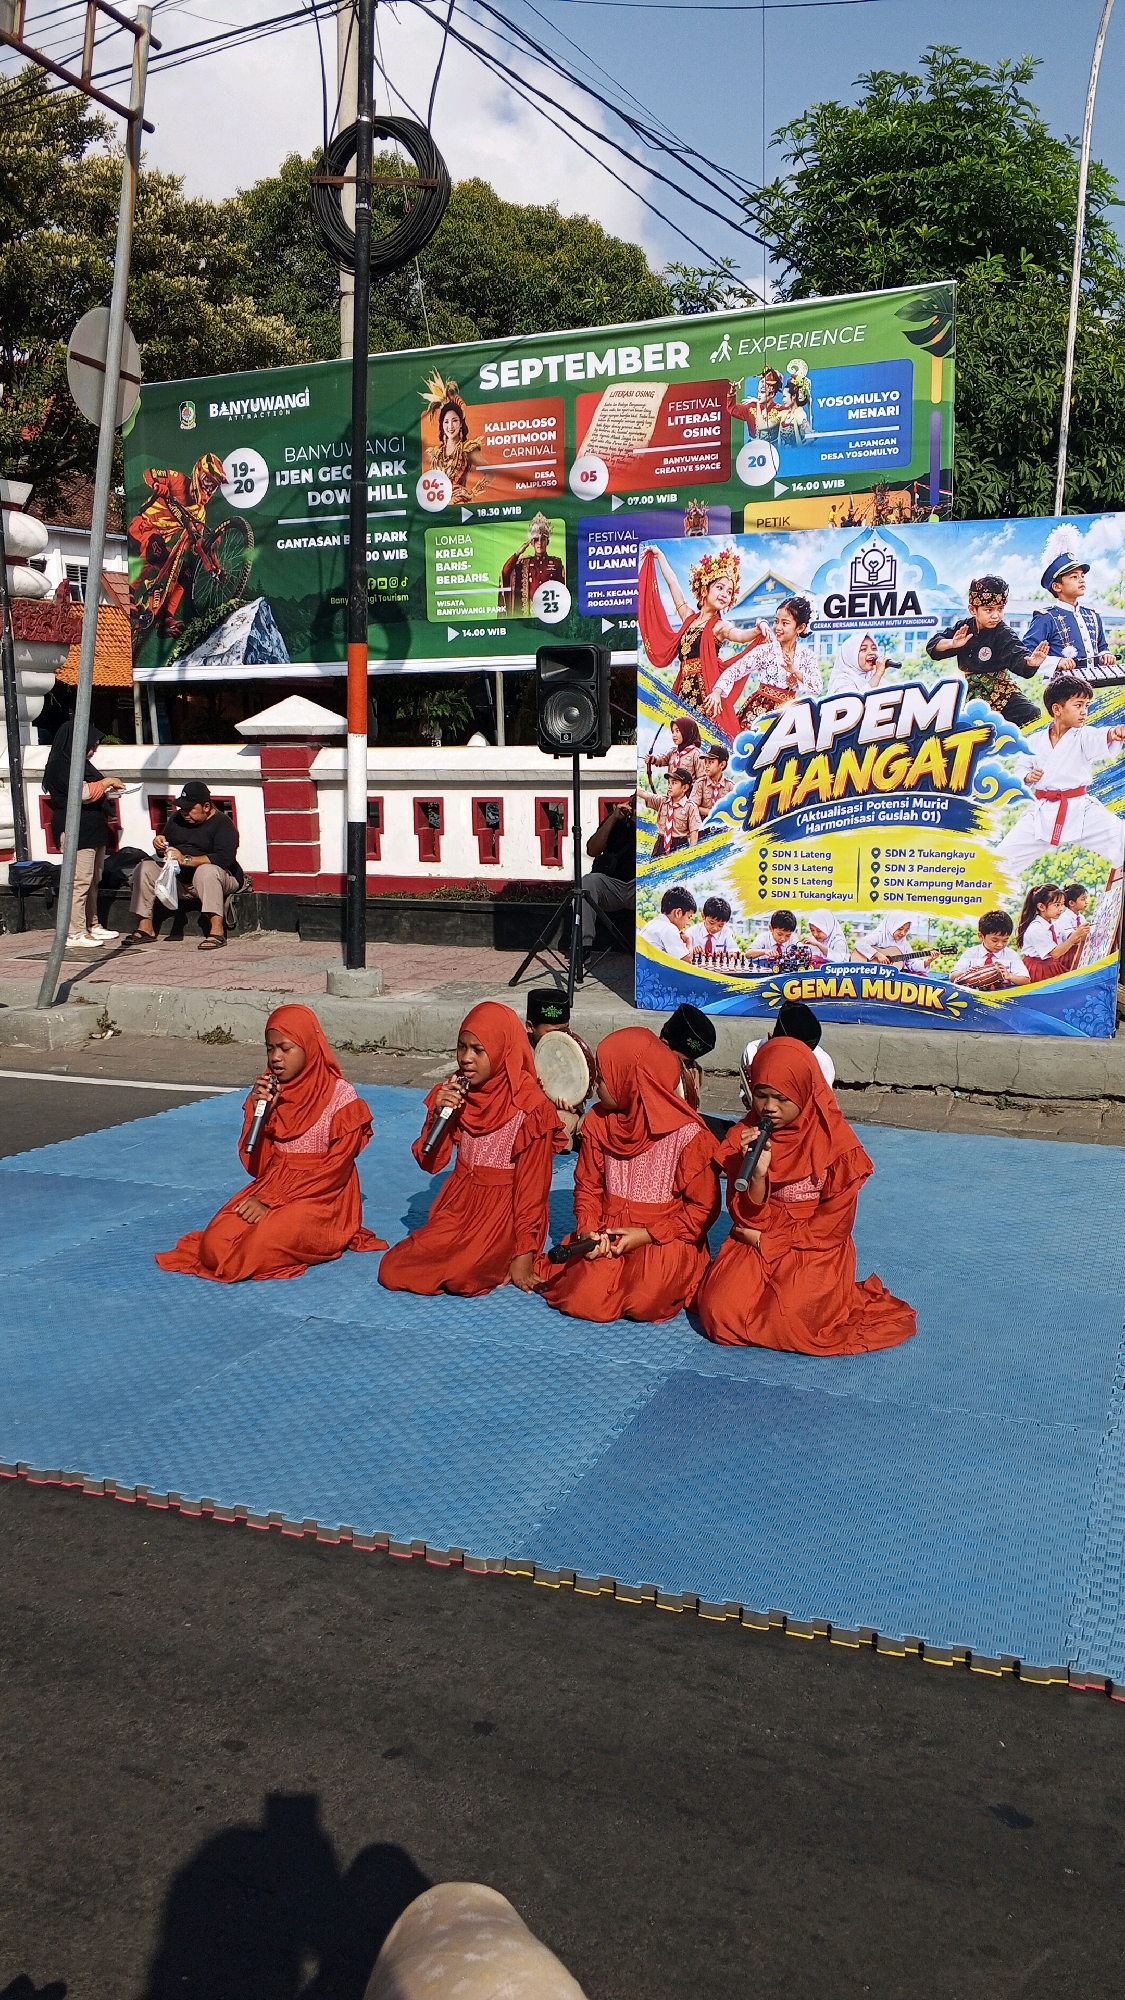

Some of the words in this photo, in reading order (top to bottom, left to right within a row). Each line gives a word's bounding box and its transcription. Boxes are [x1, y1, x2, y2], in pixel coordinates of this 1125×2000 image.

[738, 325, 867, 356] EXPERIENCE
[479, 341, 690, 390] SEPTEMBER
[209, 386, 310, 418] BANYUWANGI
[668, 397, 721, 412] FESTIVAL
[818, 391, 900, 408] YOSOMULYO
[228, 410, 291, 422] ATTRACTION
[848, 406, 900, 420] MENARI
[484, 417, 556, 433] KALIPOLOSO
[668, 412, 721, 427] LITERASI
[486, 430, 556, 446] HORTIMOON
[683, 426, 721, 438] OSING
[849, 438, 897, 448] LAPANGAN
[503, 444, 556, 458] CARNIVAL
[820, 451, 844, 461] DESA
[845, 447, 899, 458] YOSOMULYO
[663, 453, 719, 465] BANYUWANGI
[748, 454, 766, 468] 20
[232, 462, 256, 478] 19-
[276, 468, 313, 486] IJEN
[318, 460, 407, 482] GEOARK
[654, 464, 692, 474] CREATIVE
[695, 462, 721, 472] SPACE
[534, 470, 555, 479] DESA
[580, 470, 598, 482] 05
[234, 479, 255, 494] 20
[422, 479, 444, 490] 04-
[792, 482, 820, 492] 14.00
[822, 479, 845, 489] WIB
[308, 484, 408, 506] DOWHILL
[426, 490, 445, 501] 06
[627, 495, 654, 505] 07.00
[656, 494, 678, 503] WIB
[477, 507, 500, 517] 18.30
[502, 506, 522, 515] WIB
[757, 516, 790, 528] PETIK
[277, 536, 340, 549] GANTASAN
[344, 533, 371, 545] BE
[374, 531, 408, 543] PARK
[435, 535, 472, 546] LOMBA
[588, 530, 638, 543] FESTIVAL
[382, 549, 408, 561] WIB
[435, 548, 473, 558] KREASI
[588, 544, 638, 557] PADANG
[436, 561, 471, 572] BARIS-
[588, 557, 636, 570] ULANAN
[436, 573, 489, 585] BERBARIS
[378, 593, 409, 602] Tourism
[542, 590, 560, 601] 21-
[606, 589, 639, 597] KECAMA
[543, 602, 559, 613] 23
[823, 591, 922, 619] GEMA
[436, 607, 485, 616] BANYUWANGI
[618, 620, 638, 629] 15.0
[461, 628, 485, 637] 14.00
[487, 628, 506, 636] WIB
[754, 681, 961, 770] APEM
[748, 727, 993, 826] HANGAT
[796, 802, 863, 827] (Aktualisasi
[866, 798, 909, 811] Potensi
[913, 797, 948, 810] Murid
[805, 815, 875, 834] Harmonisasi
[878, 810, 919, 822] Guslah
[801, 851, 831, 860] Lateng
[918, 850, 975, 860] Tukangkayu
[801, 864, 833, 874] Lateng
[884, 864, 906, 872] SDN
[917, 865, 965, 874] Panderejo
[801, 878, 833, 887] Lateng
[884, 879, 905, 887] SDN
[907, 880, 953, 890] Kampung
[955, 880, 992, 888] Mandar
[800, 891, 853, 901] Tukangkayu
[883, 893, 904, 901] SDN
[906, 894, 982, 904] Temenggungan
[824, 965, 877, 977] Supported
[879, 966, 895, 978] by:
[783, 978, 856, 1001] GEMA
[862, 978, 945, 1010] MUDIK
